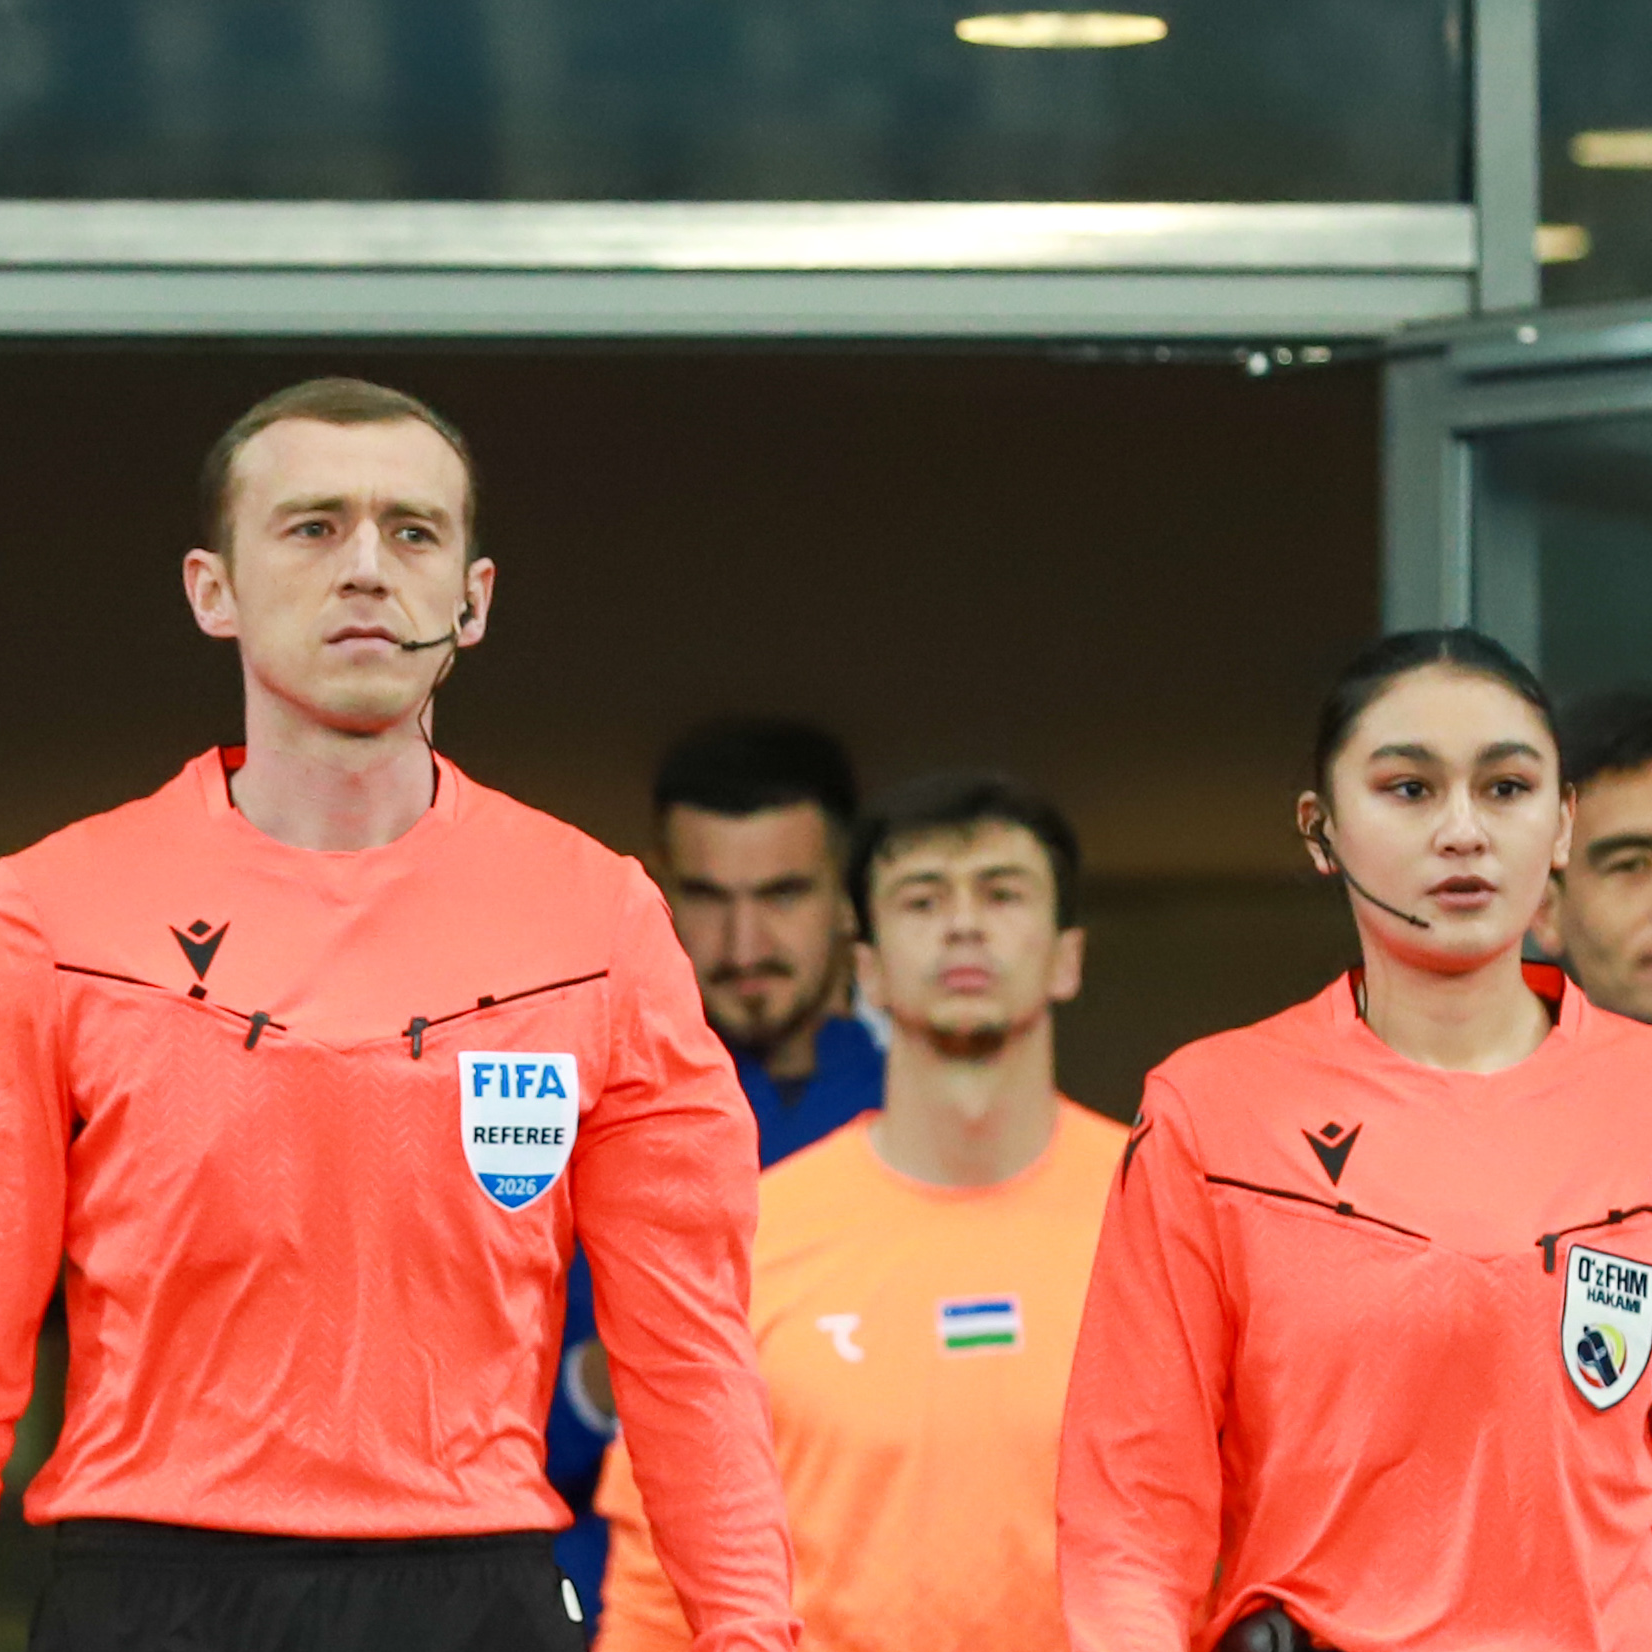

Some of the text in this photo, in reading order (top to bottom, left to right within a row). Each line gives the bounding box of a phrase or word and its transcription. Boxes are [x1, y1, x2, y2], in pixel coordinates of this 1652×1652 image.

[472, 1063, 567, 1099] FIFA
[473, 1126, 564, 1145] REFEREE
[494, 1178, 537, 1195] 2026
[1587, 1288, 1641, 1313] HAKAMI
